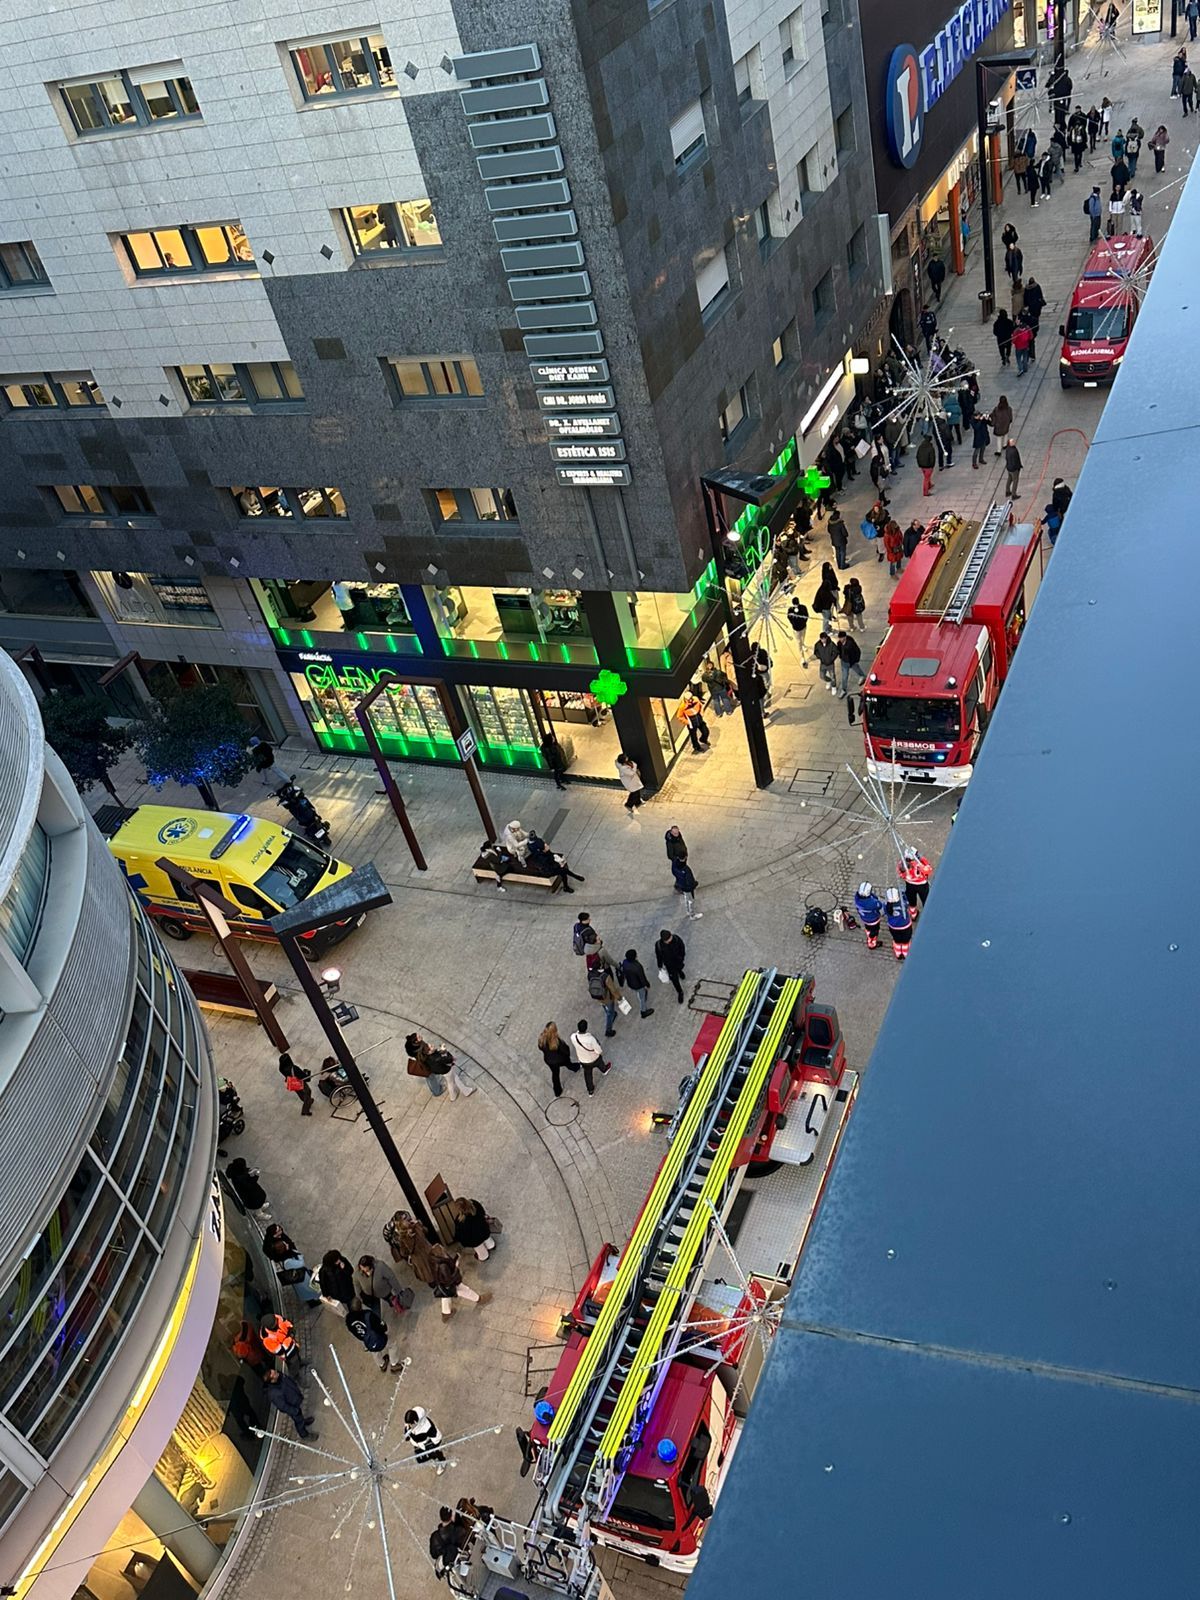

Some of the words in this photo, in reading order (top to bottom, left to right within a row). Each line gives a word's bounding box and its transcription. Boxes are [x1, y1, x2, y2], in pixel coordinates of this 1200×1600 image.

[568, 365, 598, 374] DENTAL
[548, 419, 562, 427] DR.
[598, 446, 616, 457] ISIS
